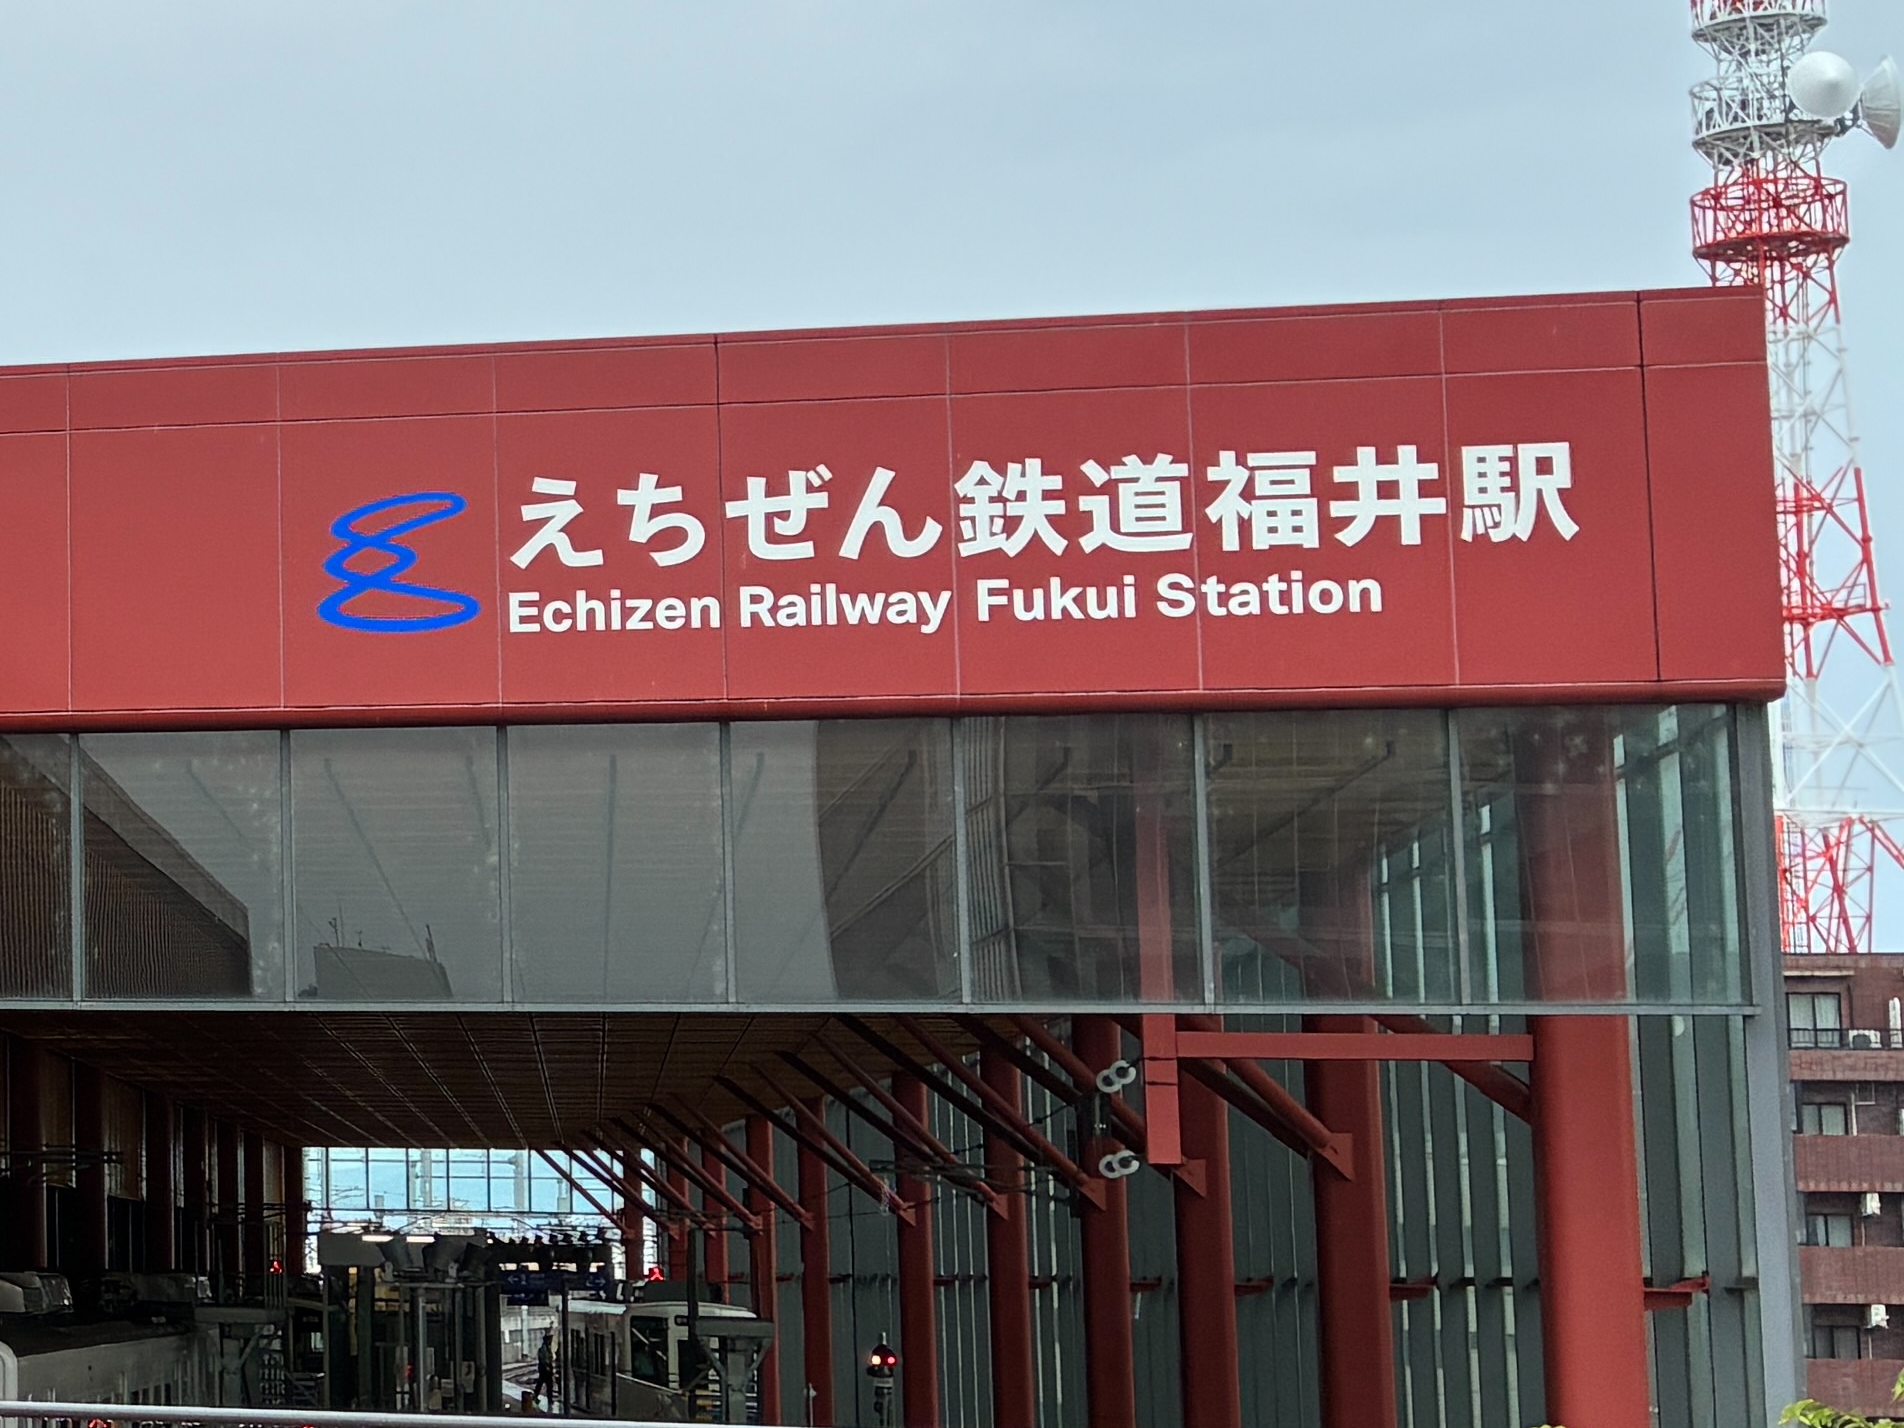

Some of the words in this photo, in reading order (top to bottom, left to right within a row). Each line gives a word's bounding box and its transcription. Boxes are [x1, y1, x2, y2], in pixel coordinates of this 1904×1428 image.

[509, 441, 1580, 570] えちぜん鉄道福井駅
[508, 590, 721, 633] Echizen
[739, 583, 952, 634] Railway
[977, 575, 1137, 623] Fukui
[1156, 570, 1383, 618] Station
